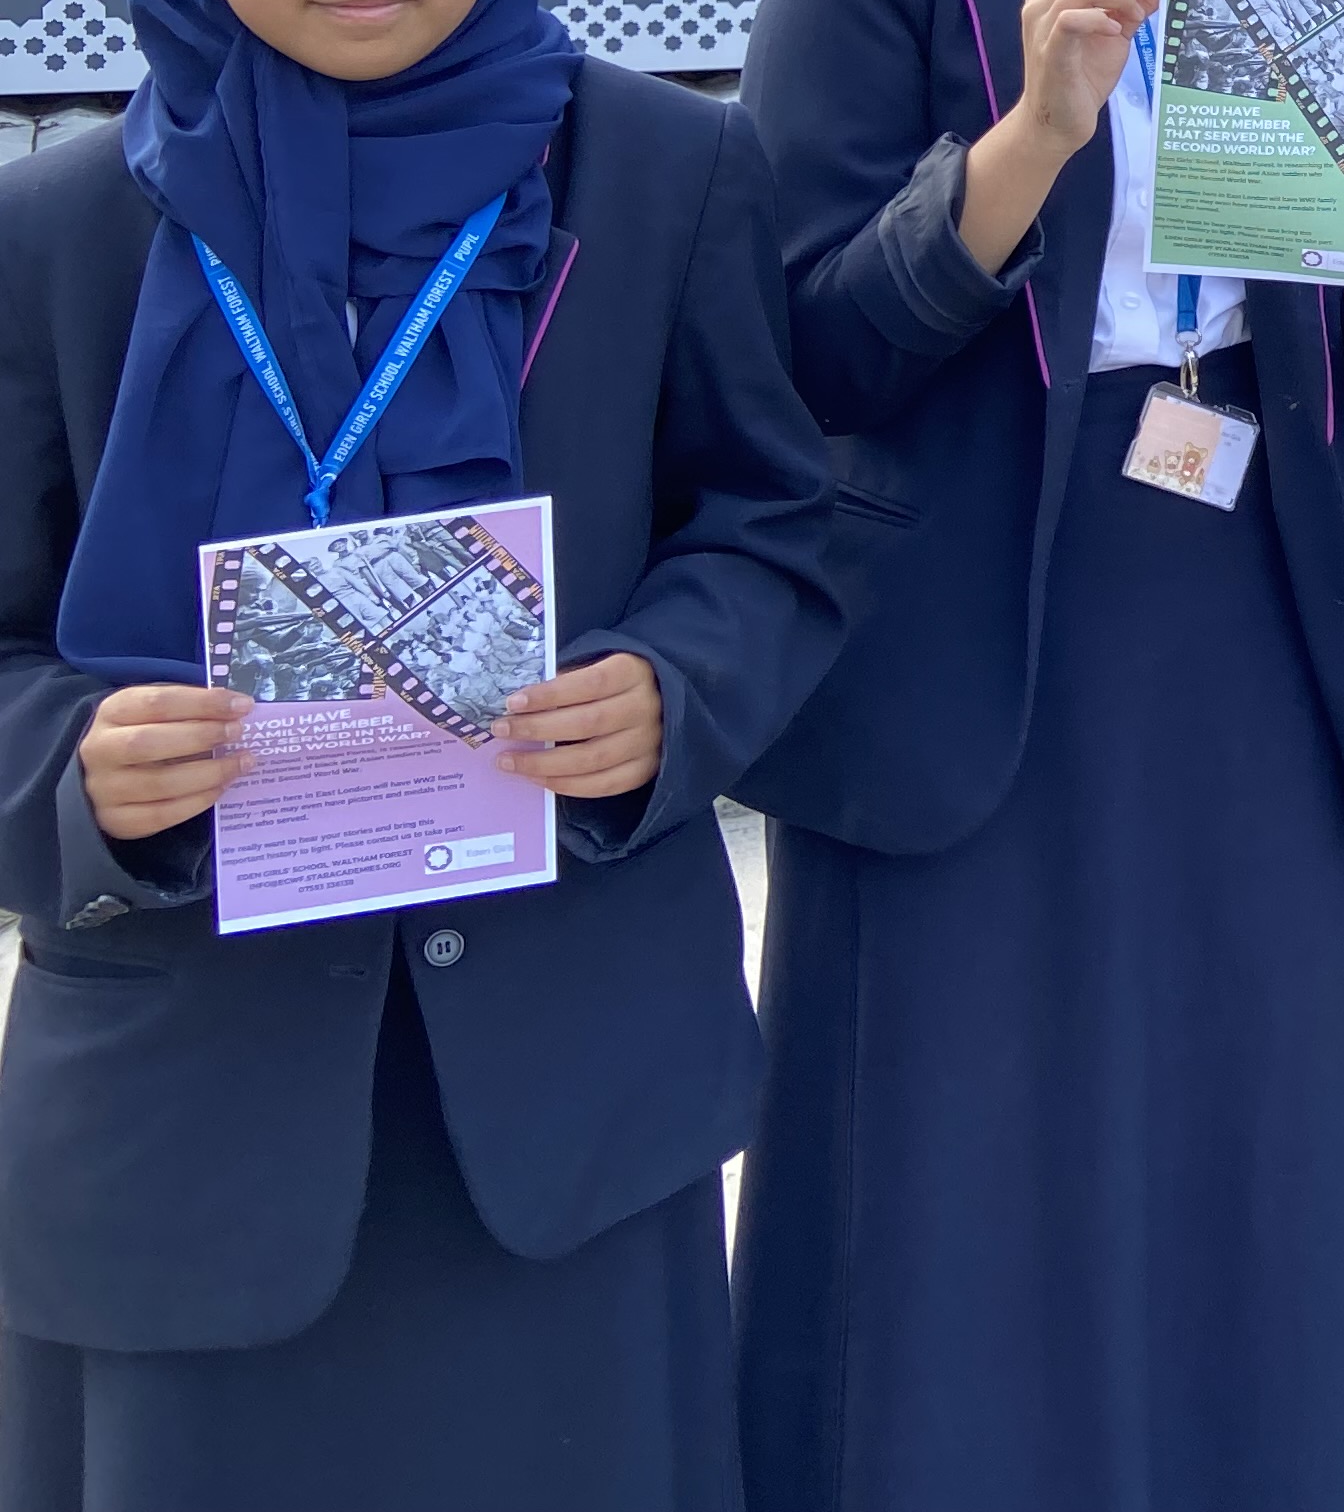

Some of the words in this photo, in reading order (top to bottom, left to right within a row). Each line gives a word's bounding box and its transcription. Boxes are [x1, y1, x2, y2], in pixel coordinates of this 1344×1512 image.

[1166, 104, 1187, 114] DO
[1190, 105, 1219, 115] YOU
[1222, 107, 1260, 116] HAVE
[1165, 117, 1175, 126] A
[1179, 118, 1230, 129] FAMILY
[1232, 119, 1290, 129] MEMBER
[1164, 129, 1201, 139] THAT
[1203, 131, 1258, 142] SERVED
[1262, 132, 1275, 142] IN
[1278, 133, 1304, 143] THE
[1163, 141, 1221, 153] SECOND
[1224, 144, 1274, 155] WORLD
[1277, 146, 1315, 156] WAR?
[217, 276, 245, 315] FOREST
[235, 313, 267, 363] WALTHAM
[333, 434, 357, 463] EDEN
[370, 360, 405, 401] SCHOOL,
[395, 308, 433, 358] WALTHAM
[423, 269, 455, 309] FOREST
[454, 233, 479, 261] PUPIL
[242, 725, 307, 740] FAMILY
[309, 714, 394, 735] MEMBER
[251, 716, 294, 731] YOU
[300, 708, 351, 724] HAVE
[275, 730, 351, 744] SERVED
[355, 727, 372, 737] IN
[375, 724, 414, 735] THE
[306, 737, 374, 750] WORLD
[378, 731, 431, 742] WAR?
[220, 800, 243, 810] Many
[246, 796, 281, 807] families
[283, 794, 302, 803] here
[304, 791, 313, 800] in
[315, 789, 335, 798] East
[338, 785, 371, 796] London
[373, 782, 388, 791] will
[390, 780, 411, 789] have
[413, 777, 436, 786] WW2
[438, 773, 463, 784] family
